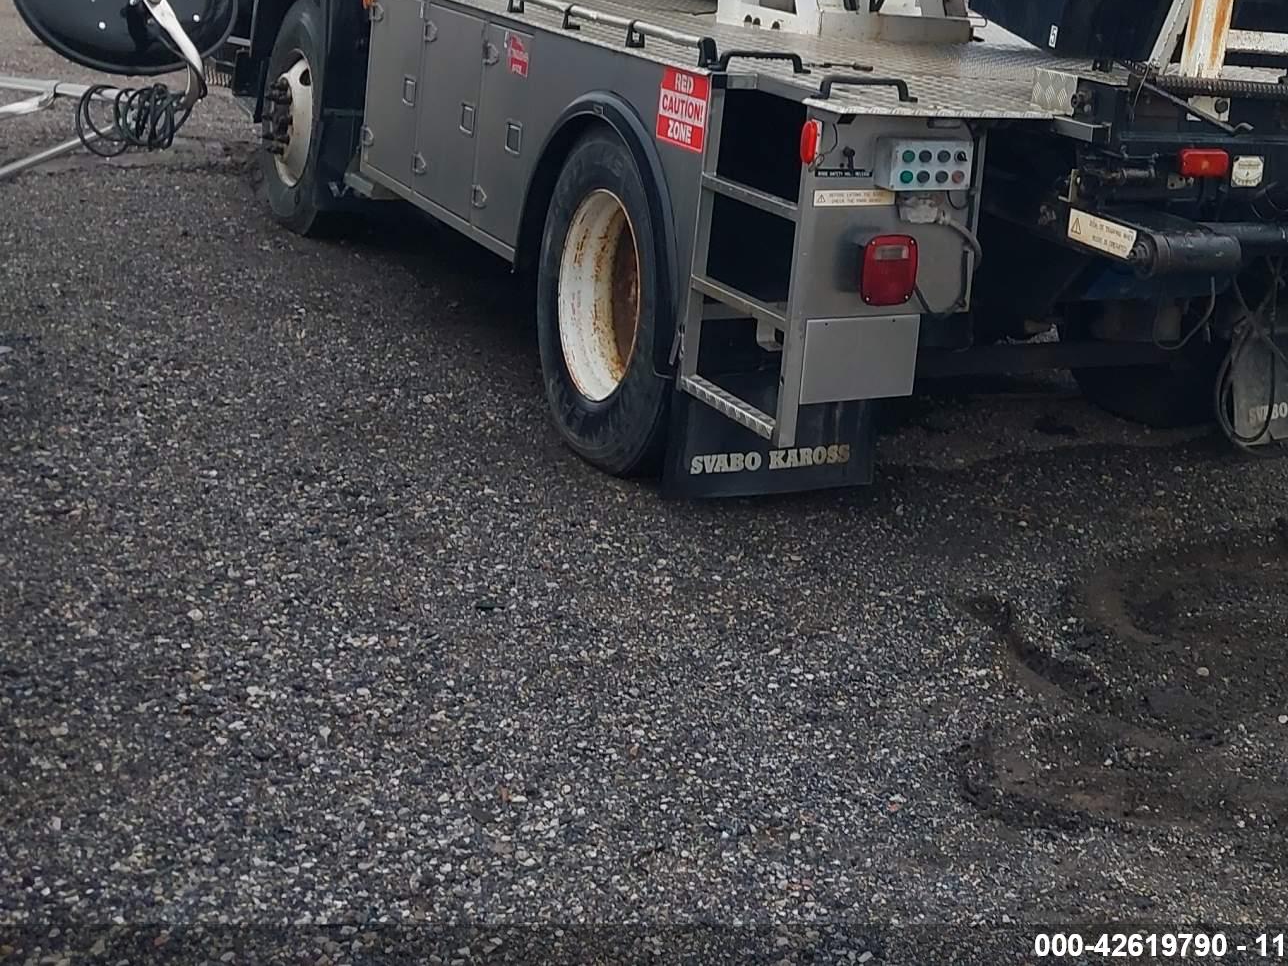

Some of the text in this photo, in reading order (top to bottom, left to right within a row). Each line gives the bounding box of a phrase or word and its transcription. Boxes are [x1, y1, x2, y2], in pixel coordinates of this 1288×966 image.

[675, 72, 694, 94] RED
[662, 94, 704, 122] CAUTION!
[668, 119, 692, 144] ZONE
[690, 444, 850, 475] SVABO KAROSS
